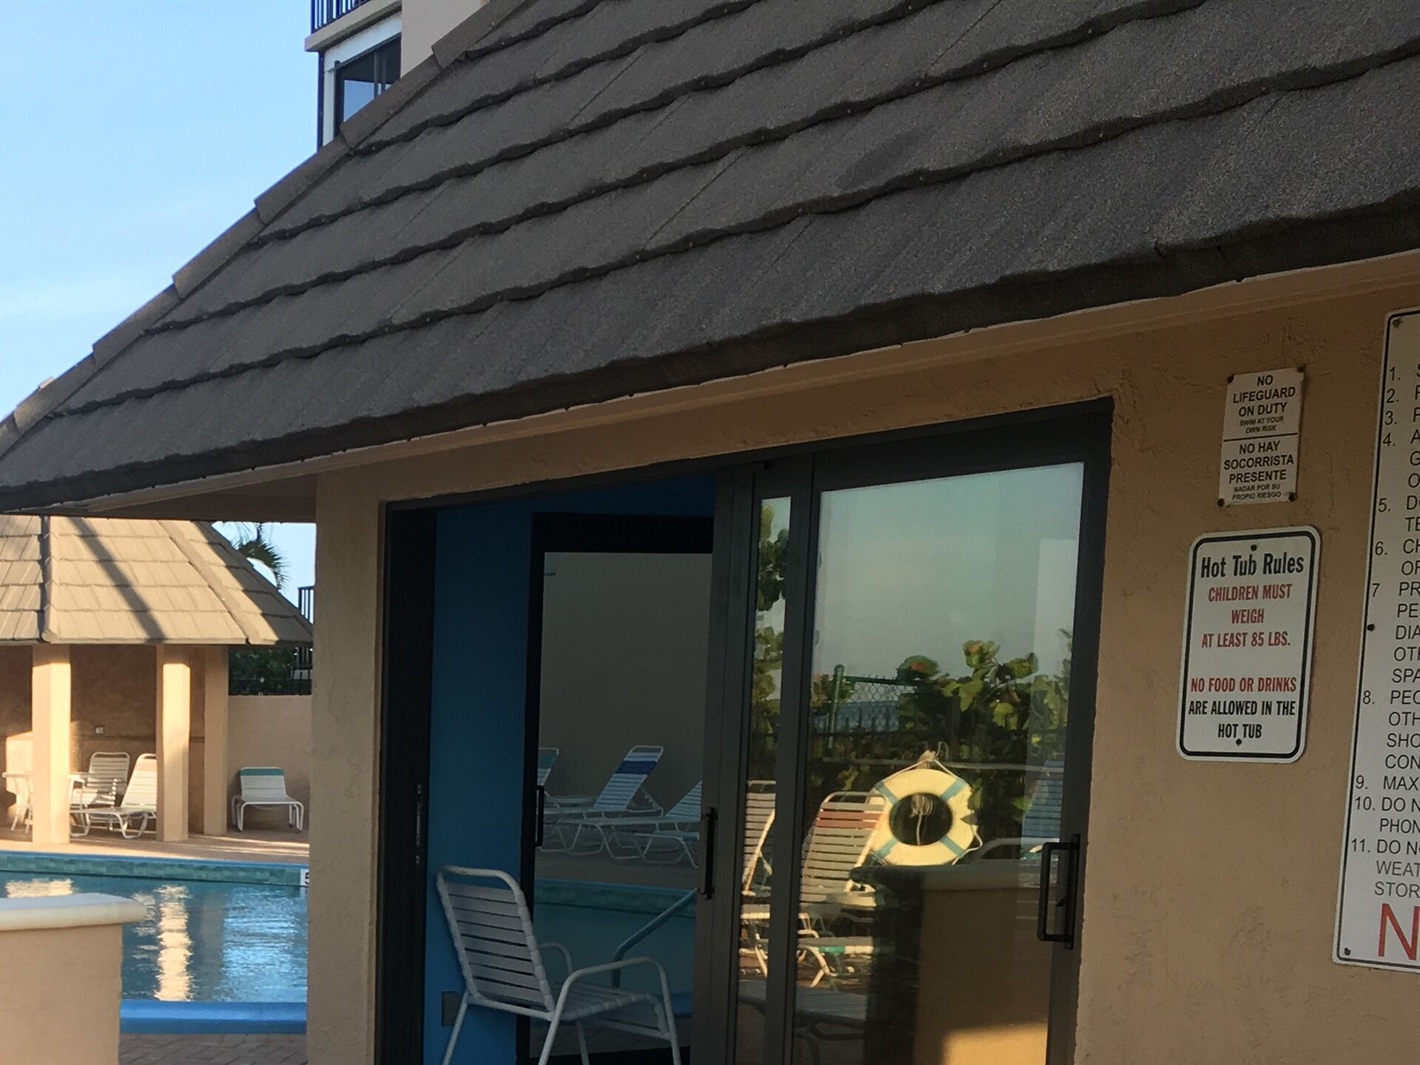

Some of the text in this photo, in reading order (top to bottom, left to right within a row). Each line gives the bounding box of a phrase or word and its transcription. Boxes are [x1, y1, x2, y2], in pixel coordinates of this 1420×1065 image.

[1257, 374, 1273, 386] NO
[1389, 366, 1401, 381] 1.
[1233, 386, 1296, 403] LIFEGUARD
[1386, 388, 1399, 404] 2.
[1238, 402, 1288, 417] ON DUTY
[1240, 416, 1284, 426] SWIM AT YOUR
[1384, 410, 1398, 425] 3.
[1245, 426, 1261, 434] OWN
[1383, 432, 1396, 447] 4.
[1239, 440, 1281, 455] NO HAY
[1223, 454, 1294, 470] SOCORRISTA
[1229, 469, 1287, 484] PRESENTE
[1256, 483, 1270, 491] POR
[1232, 491, 1281, 500] PROPIO RIESGO
[1378, 495, 1420, 512] 5. D
[1375, 541, 1387, 556] 6.
[1201, 552, 1304, 578] Hot Tub Rules
[1208, 583, 1292, 602] CHILDREN MUST
[1372, 583, 1380, 597] 7
[1231, 608, 1265, 624] WEIGH
[1201, 631, 1291, 648] AT LEAST 85 LBS.
[1394, 646, 1420, 662] OT
[1191, 677, 1297, 692] NO FOOD OR DRINKS
[1362, 690, 1375, 705] 8.
[1188, 700, 1296, 715] ARE ALLOWED IN THE
[1217, 723, 1262, 738] HOT TUB
[1356, 774, 1420, 791] 9. MAX
[1355, 796, 1376, 811] 10.
[1381, 797, 1406, 812] DO
[1351, 838, 1420, 856] 11. DO N
